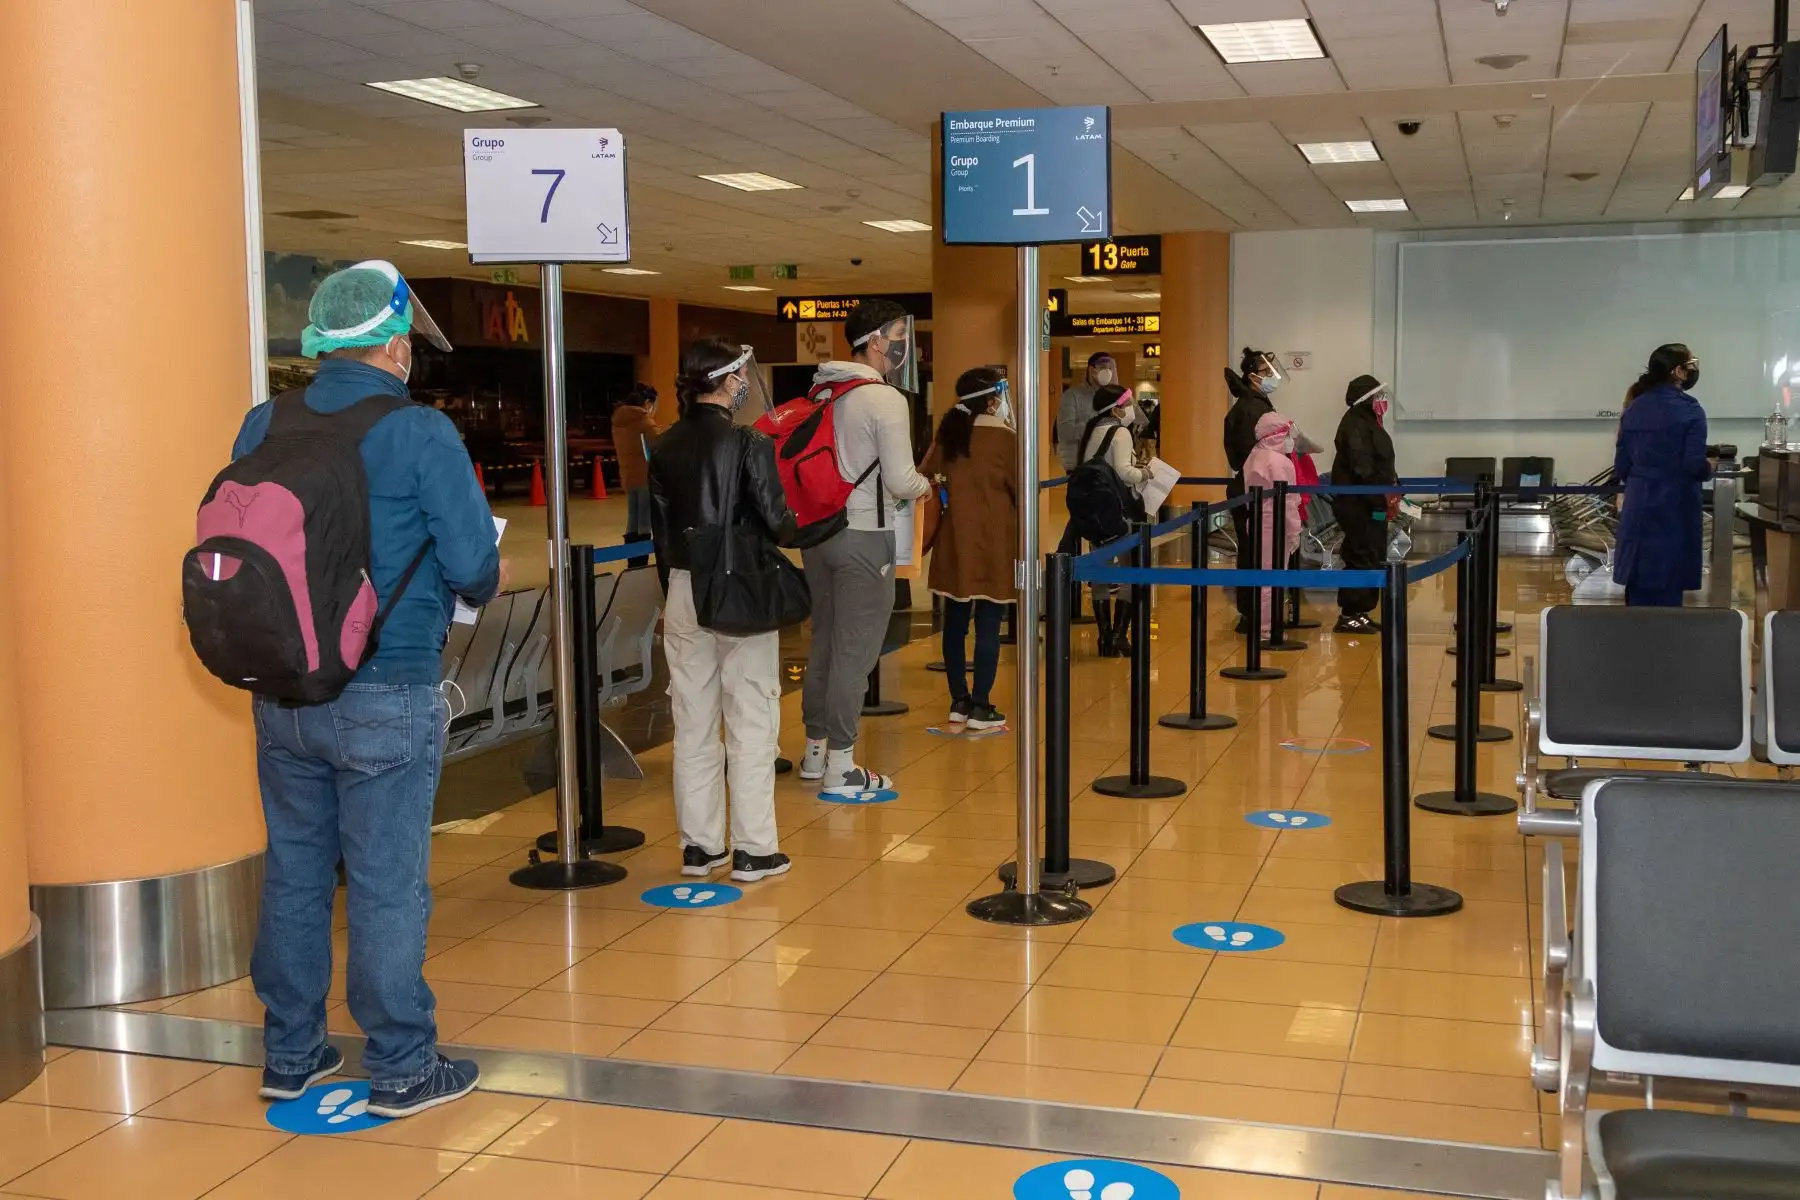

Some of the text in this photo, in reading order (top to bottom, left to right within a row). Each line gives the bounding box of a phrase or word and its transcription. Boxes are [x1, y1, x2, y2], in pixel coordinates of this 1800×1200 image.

[950, 117, 1035, 131] Embarque Premium
[472, 137, 505, 150] Grupo
[950, 134, 1000, 144] Premium Boarding
[472, 154, 492, 162] Group
[951, 156, 978, 168] Grupo
[951, 169, 968, 177] Group
[1012, 153, 1050, 216] 1
[532, 169, 566, 223] 7
[1120, 246, 1149, 256] Puerta
[1089, 244, 1118, 270] 13
[1120, 260, 1137, 268] Gate
[816, 300, 840, 308] Puertas
[1072, 318, 1087, 326] Salas
[1096, 317, 1122, 326] Embarque
[1124, 316, 1132, 324] 14
